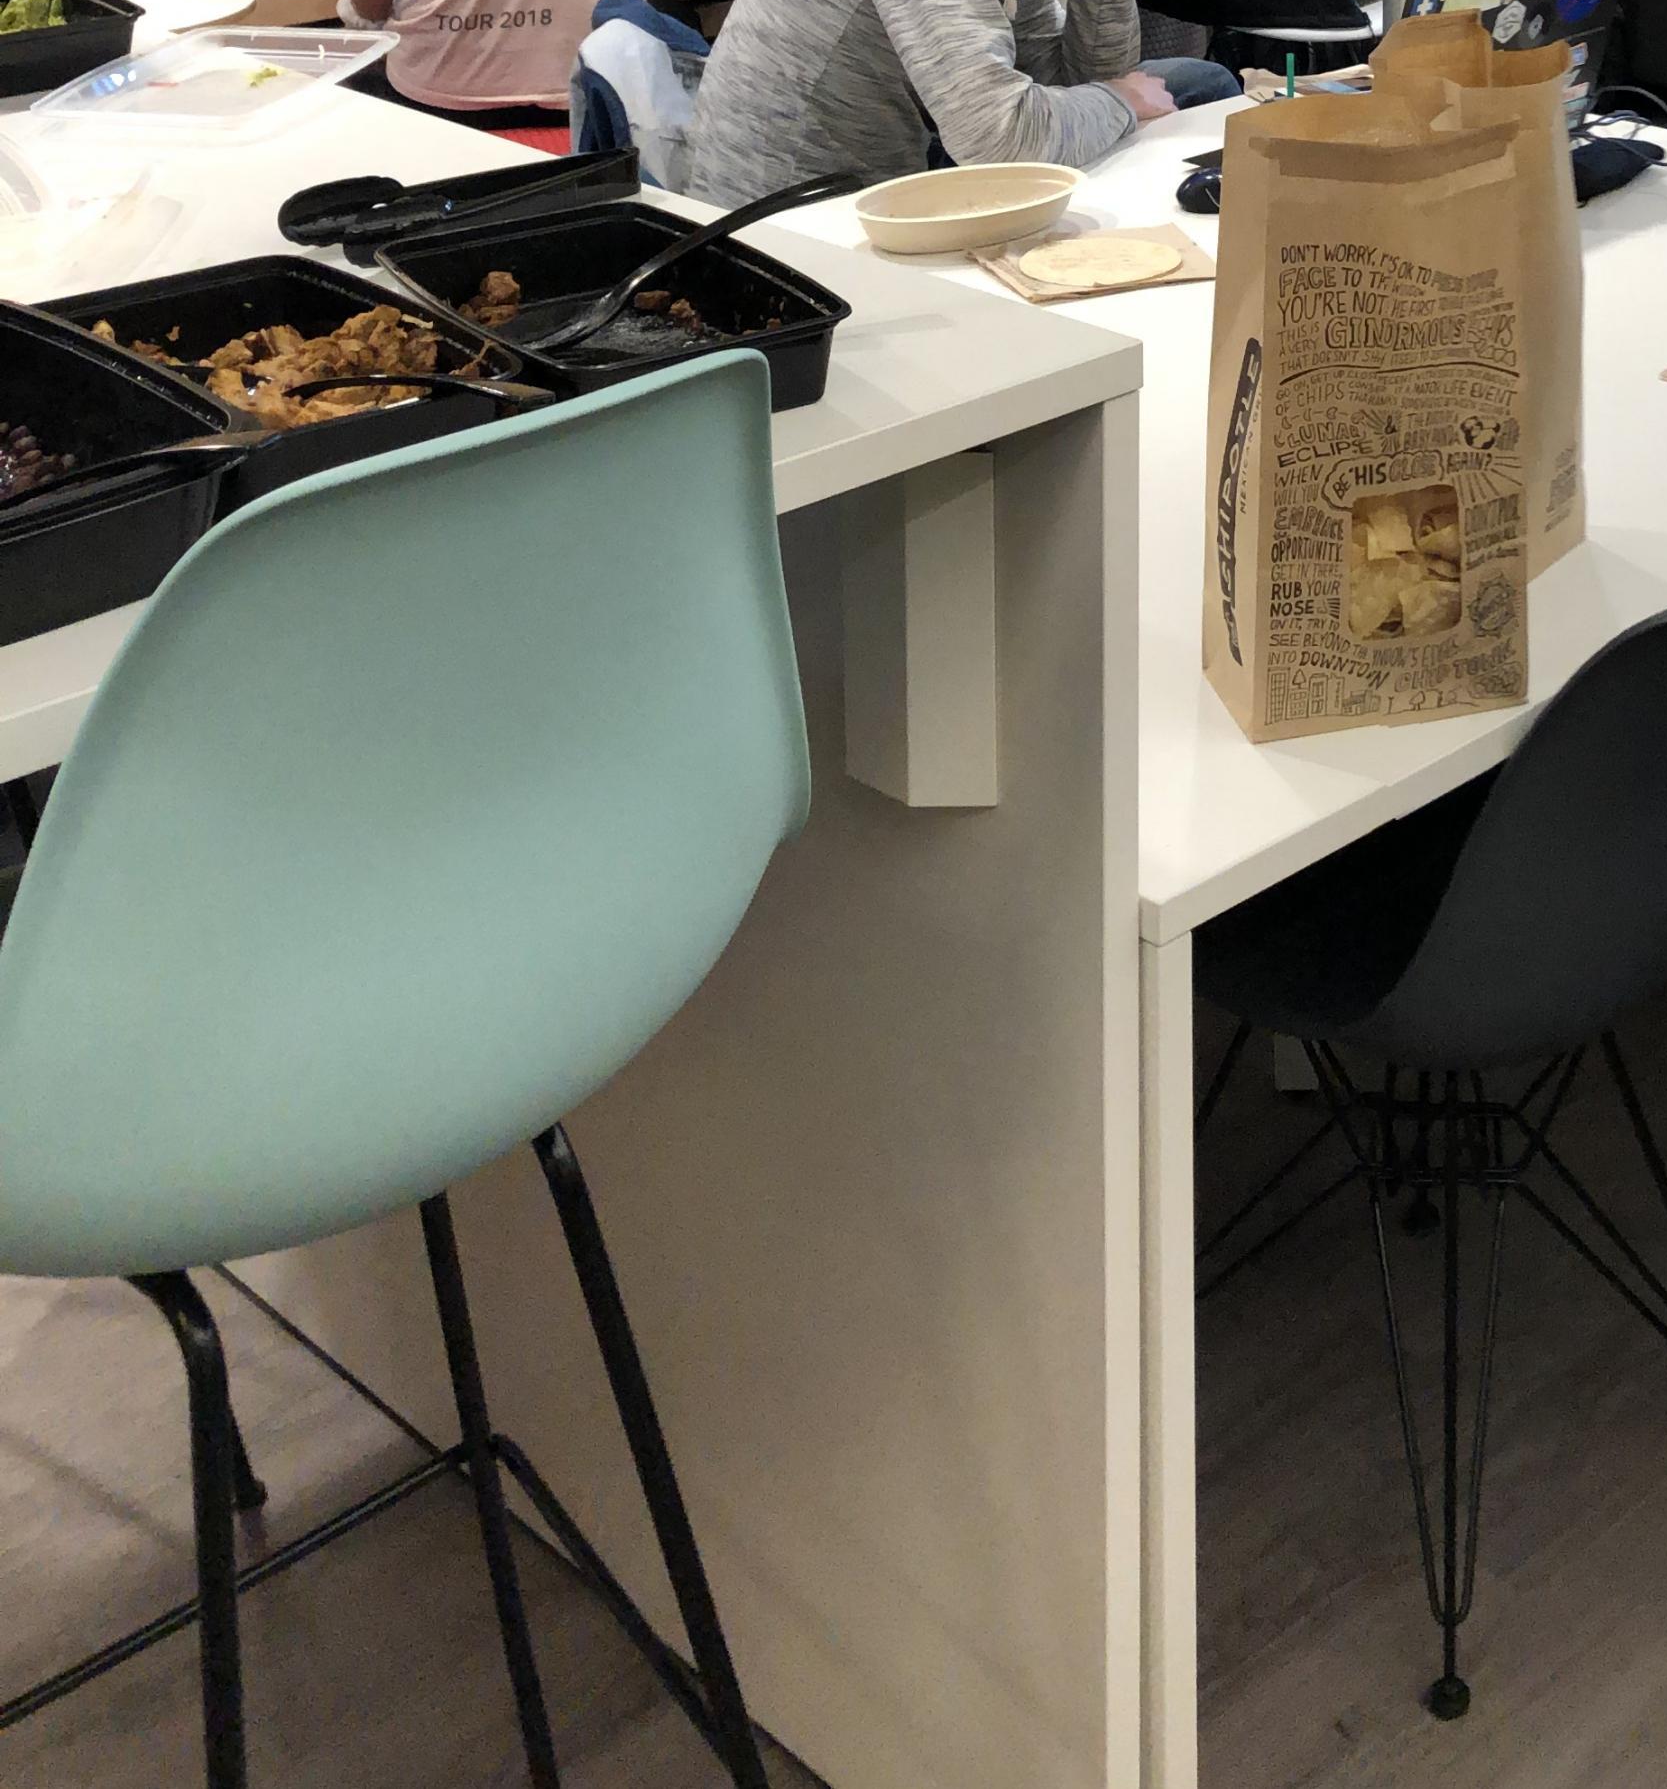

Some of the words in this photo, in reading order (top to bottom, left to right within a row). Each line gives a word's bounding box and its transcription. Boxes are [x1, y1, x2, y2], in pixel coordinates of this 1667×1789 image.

[436, 14, 493, 32] TOUR
[501, 9, 553, 29] 2018
[1281, 244, 1319, 264] DON'T
[1415, 266, 1432, 285] TO
[1279, 267, 1337, 298] FACE
[1342, 267, 1362, 289] TO
[1277, 290, 1347, 327] YOU'RE
[1353, 291, 1389, 316] NOT
[1277, 323, 1306, 347] THIS
[1310, 321, 1319, 336] IS
[1279, 353, 1308, 375] THAT
[1311, 349, 1360, 367] DOESN'T
[1275, 402, 1290, 417] OF
[1296, 380, 1346, 408] CHIPS
[1276, 439, 1375, 469] ECLIPSE
[1239, 431, 1254, 515] MEXICAN
[1274, 463, 1324, 488] WHEN
[1332, 473, 1351, 501] BE
[1271, 564, 1295, 582] GET
[1271, 581, 1303, 601] RUB
[1305, 579, 1341, 599] YOUR
[1270, 599, 1315, 617] NOSE
[1269, 633, 1300, 647] SEE
[1268, 650, 1298, 666] INTO
